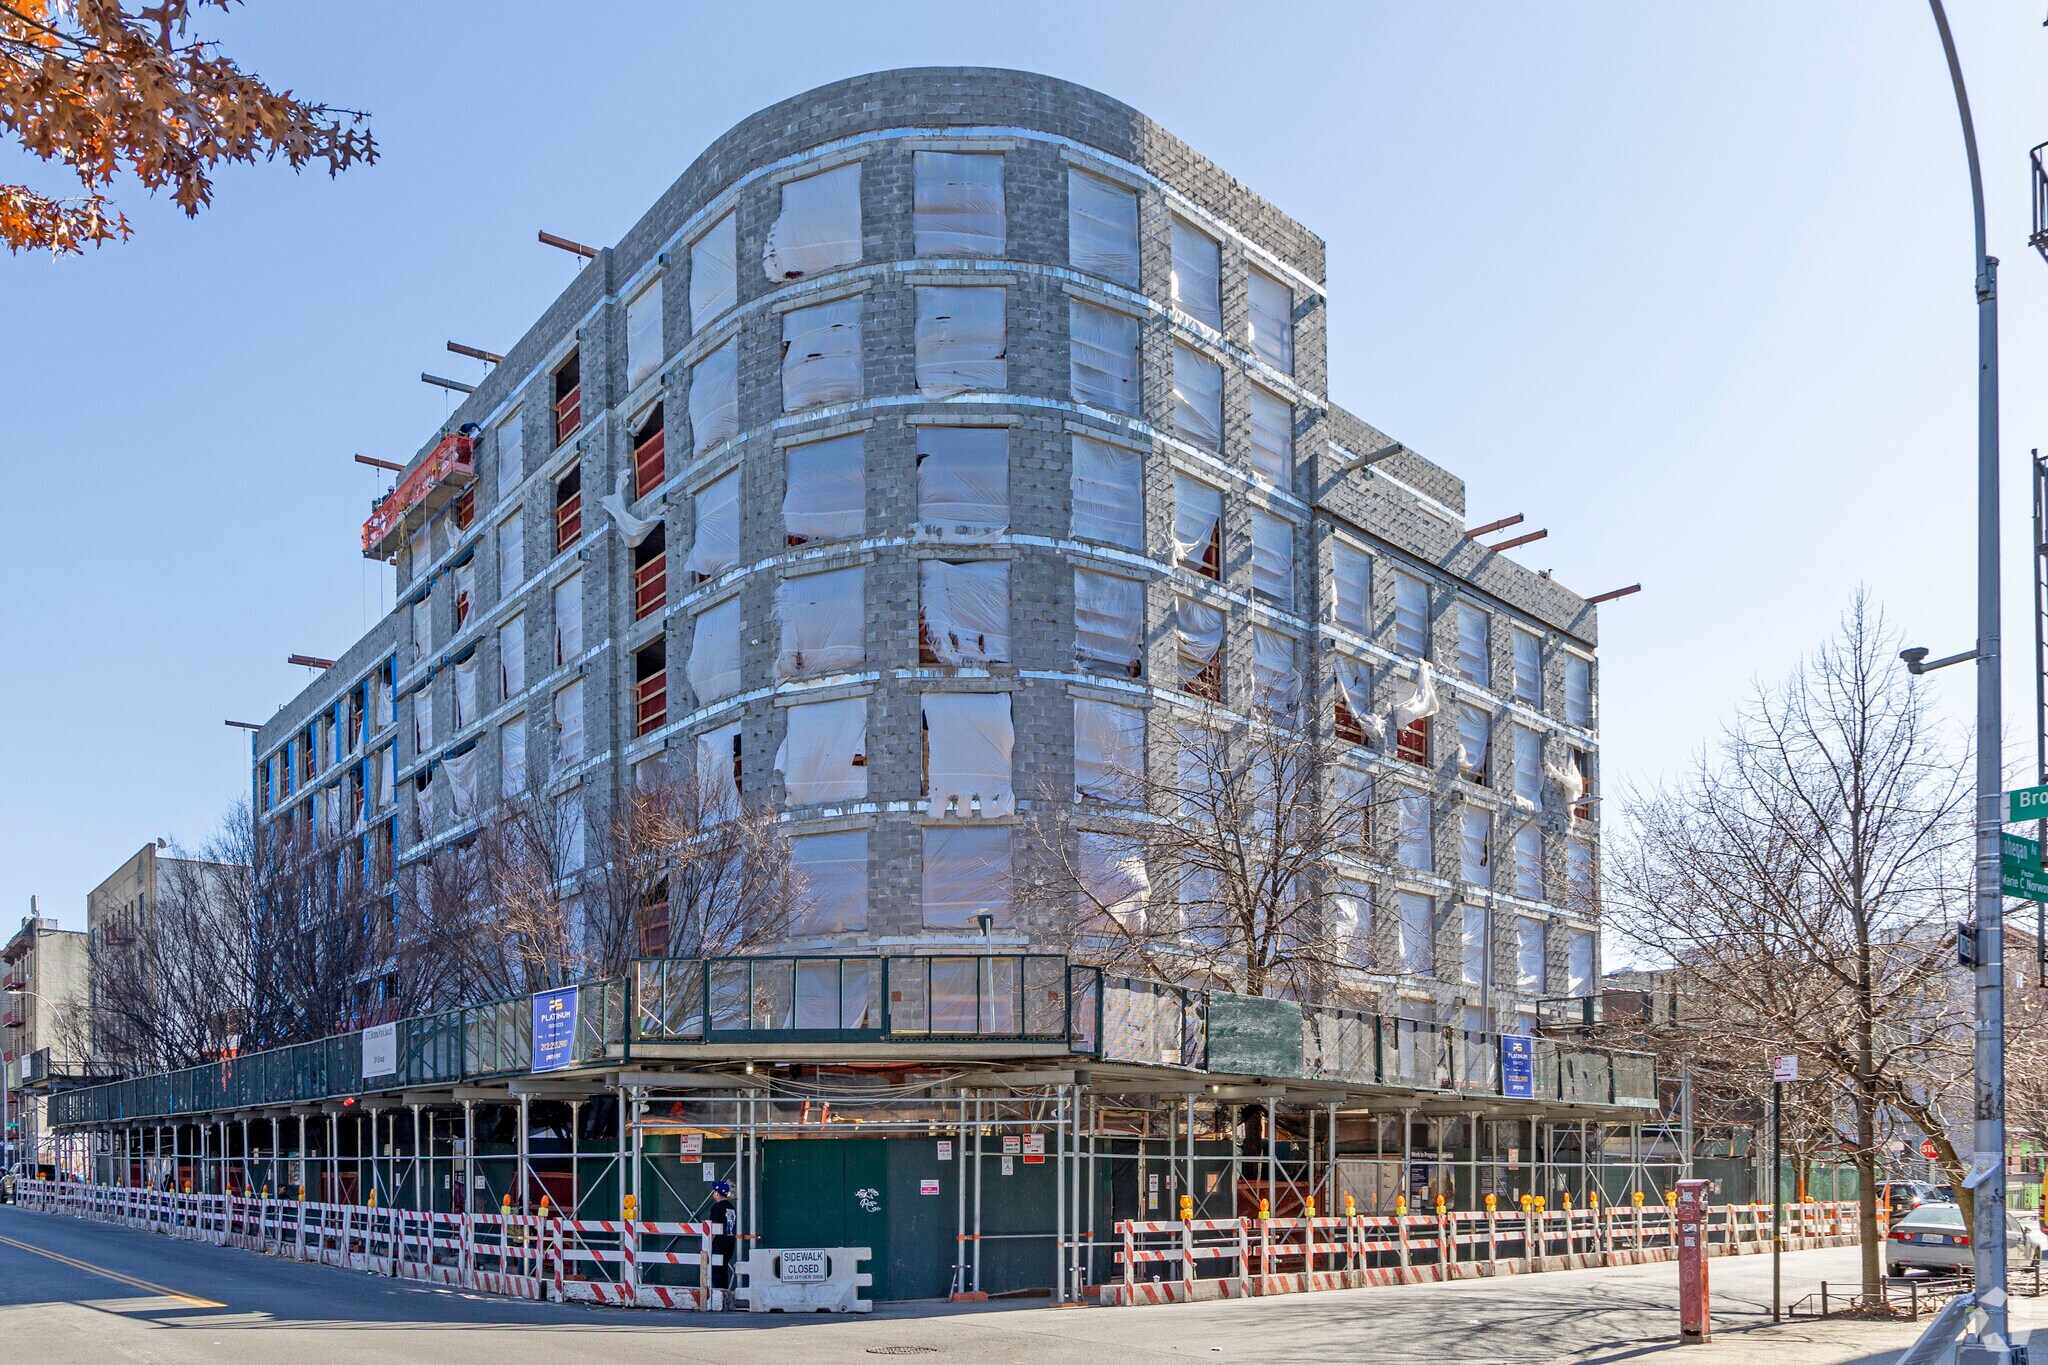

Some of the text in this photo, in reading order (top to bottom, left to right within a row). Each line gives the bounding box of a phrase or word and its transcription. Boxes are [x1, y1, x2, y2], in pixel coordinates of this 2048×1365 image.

[2019, 791, 2048, 808] Bro
[2002, 836, 2028, 864] ohegan
[541, 1011, 571, 1023] PLATINUM
[783, 1252, 824, 1262] SIDEWALK
[788, 1264, 820, 1274] CLOSED
